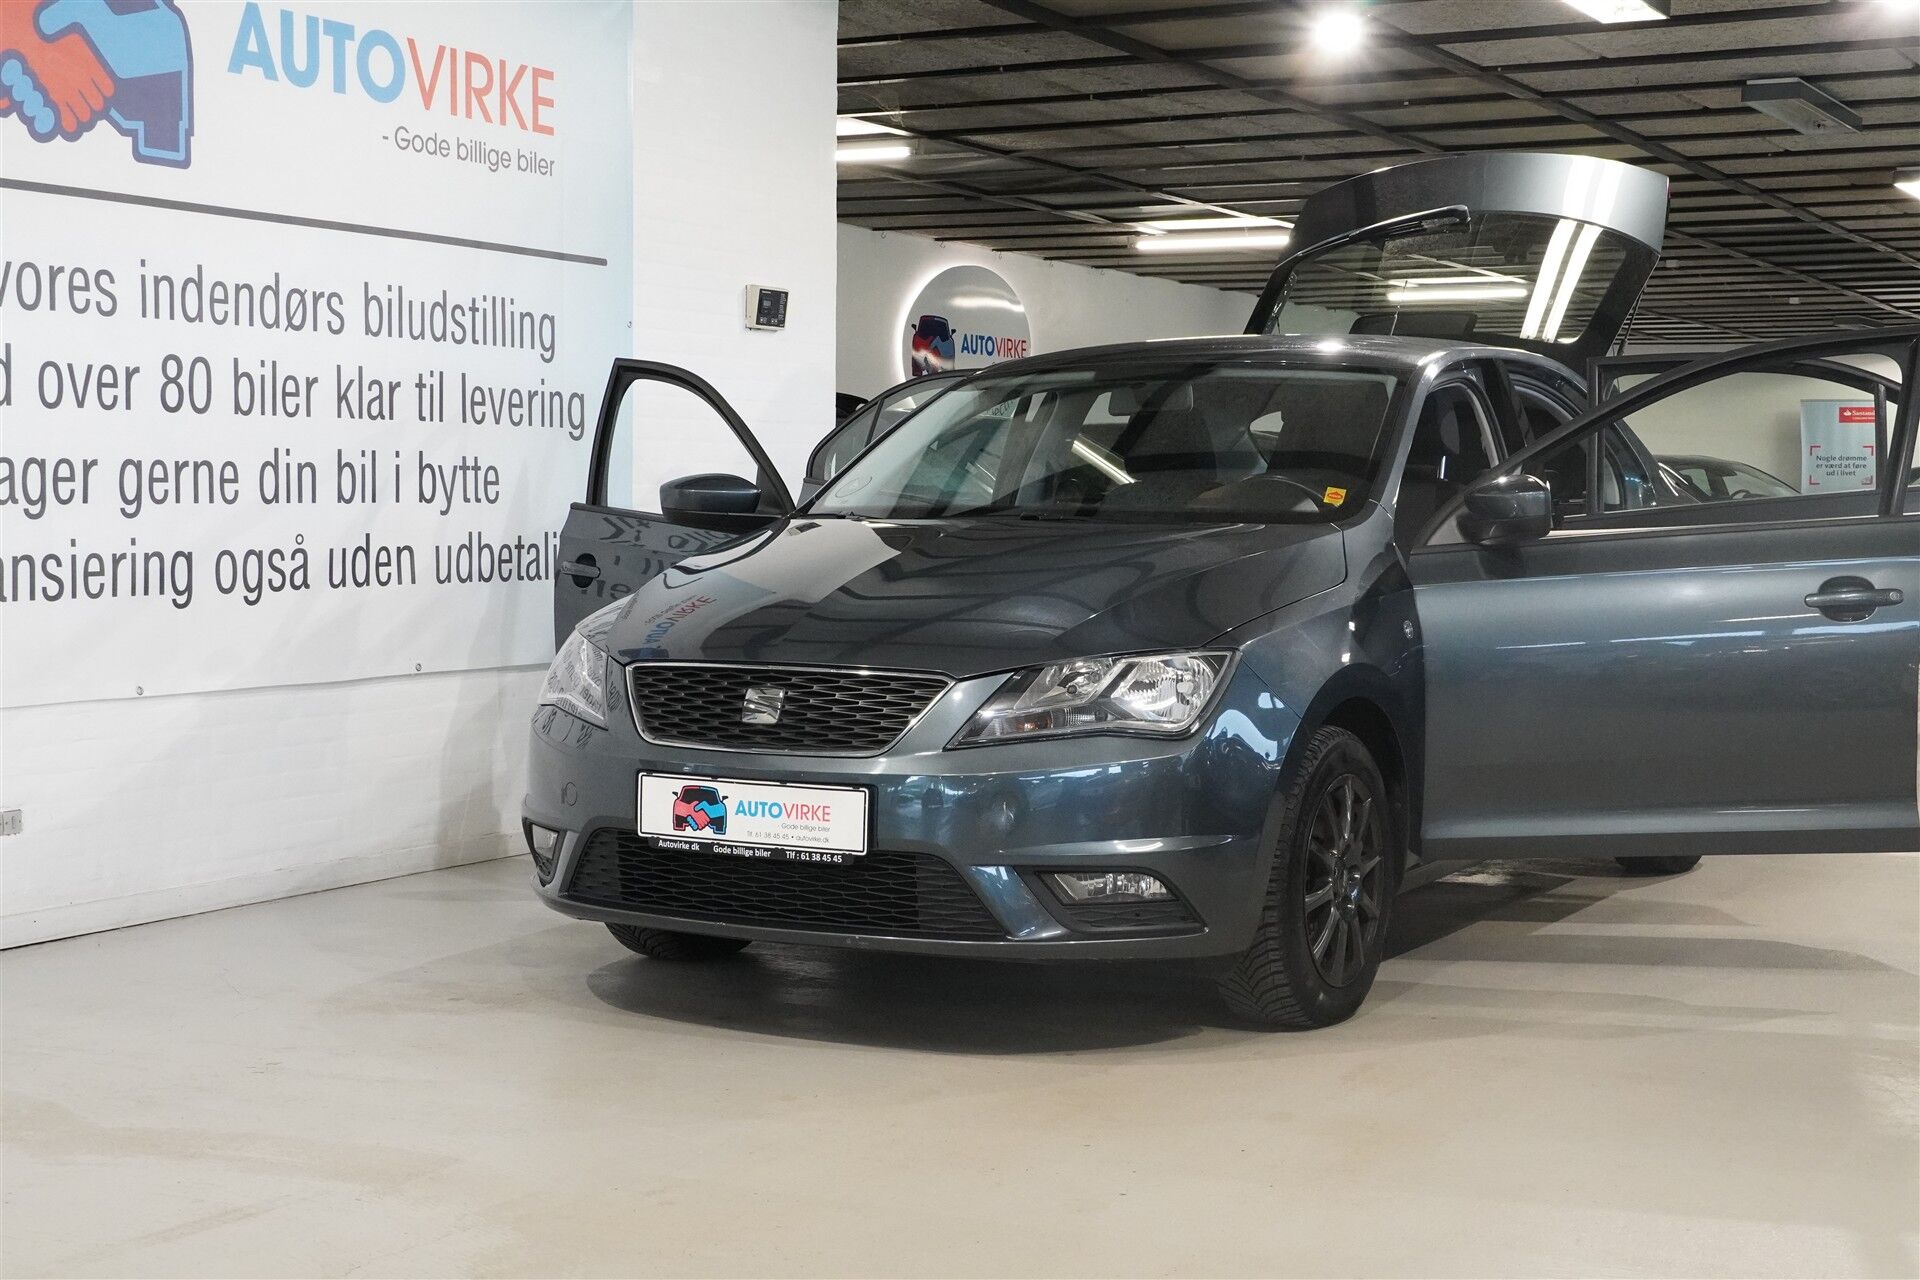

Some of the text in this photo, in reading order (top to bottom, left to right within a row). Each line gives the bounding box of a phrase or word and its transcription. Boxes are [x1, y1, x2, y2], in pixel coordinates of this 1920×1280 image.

[227, 1, 555, 137] AUTOVIRKE
[394, 126, 450, 157] Gode
[456, 137, 511, 172] billige
[517, 149, 555, 177] biler
[140, 259, 345, 335] indendørs
[364, 281, 556, 363] biludstilling
[38, 361, 140, 411] over
[160, 353, 212, 414] 80
[233, 357, 318, 418] biler
[336, 364, 401, 421] klar
[415, 370, 444, 422] til
[461, 373, 585, 441] levering
[119, 459, 239, 519] gerne
[259, 447, 317, 504] din
[337, 449, 377, 504] bil
[395, 450, 400, 503] i
[419, 451, 500, 516] bytte
[215, 533, 310, 606] også
[328, 533, 416, 589] uden
[735, 800, 831, 822] AUTOVIRKE
[781, 823, 799, 831] Gode
[800, 824, 817, 832] billige
[658, 840, 690, 850] Autovirke
[713, 845, 771, 857] Gode billige biler
[801, 852, 810, 860] 61
[812, 853, 821, 861] 38
[822, 854, 831, 862] 45
[833, 855, 842, 863] 45
